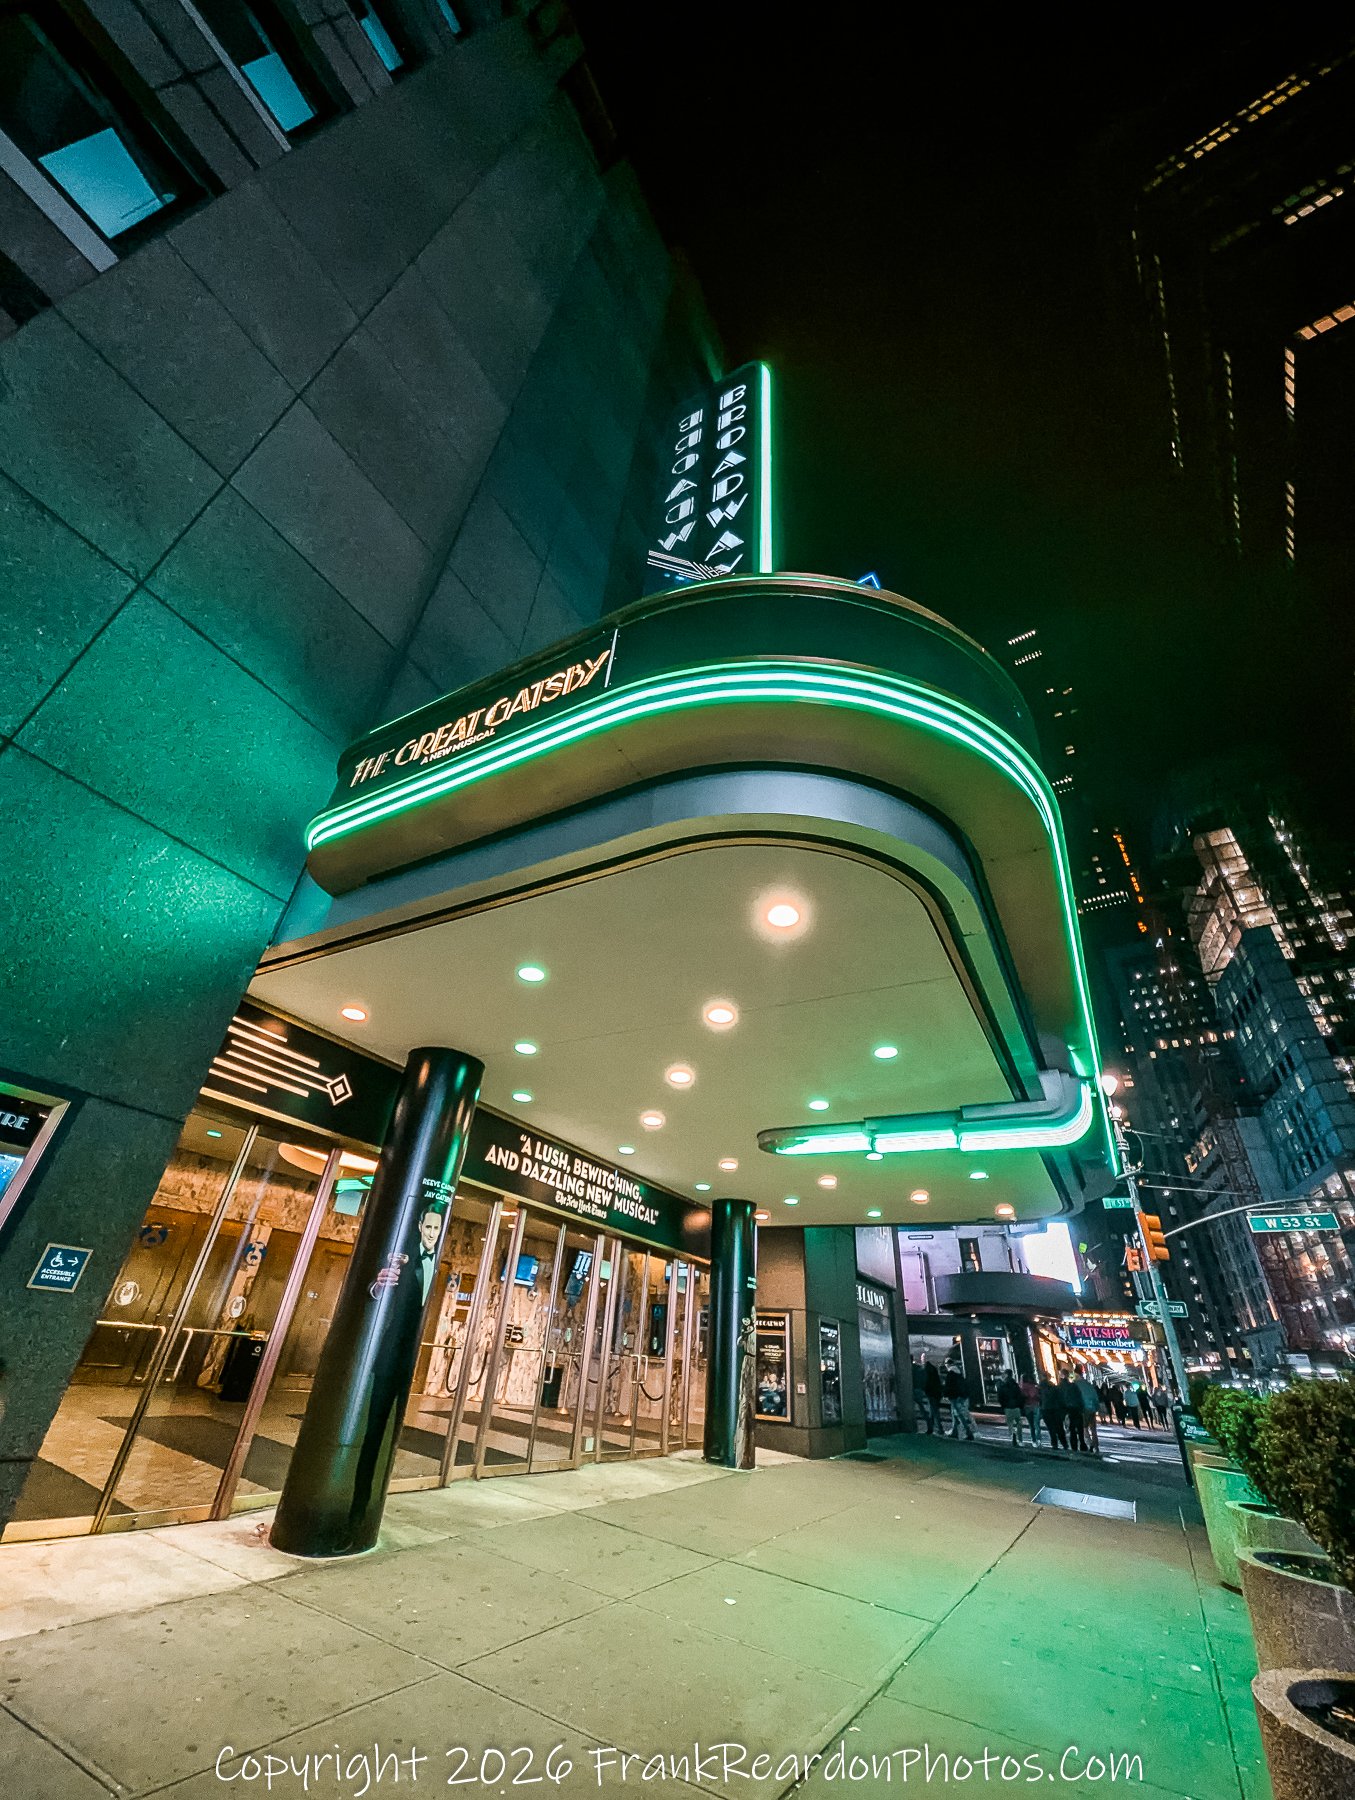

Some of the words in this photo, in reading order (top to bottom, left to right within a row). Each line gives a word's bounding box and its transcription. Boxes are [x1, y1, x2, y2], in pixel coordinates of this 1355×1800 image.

[350, 748, 396, 788] THE
[395, 707, 486, 766] GREAT
[485, 650, 610, 728] GATSBY
[420, 756, 428, 765] A
[429, 746, 452, 761] NEW
[452, 728, 495, 752] MUSICAL
[485, 1144, 519, 1171] AND
[521, 1157, 585, 1197] DAZZLING
[586, 1183, 612, 1207] NEW
[534, 1141, 571, 1173] LUSH,
[573, 1158, 643, 1204] BEWITCHING,
[555, 1190, 567, 1205] The
[1264, 1218, 1278, 1228] W
[1281, 1217, 1301, 1228] 53
[1303, 1216, 1322, 1227] St
[41, 1268, 76, 1277] ACCESSIBLE
[41, 1274, 72, 1282] ENTRANCE
[1073, 1326, 1101, 1338] LATE
[1101, 1328, 1130, 1339] SHOW
[1076, 1337, 1106, 1347] stephen
[1107, 1337, 1136, 1348] colbert
